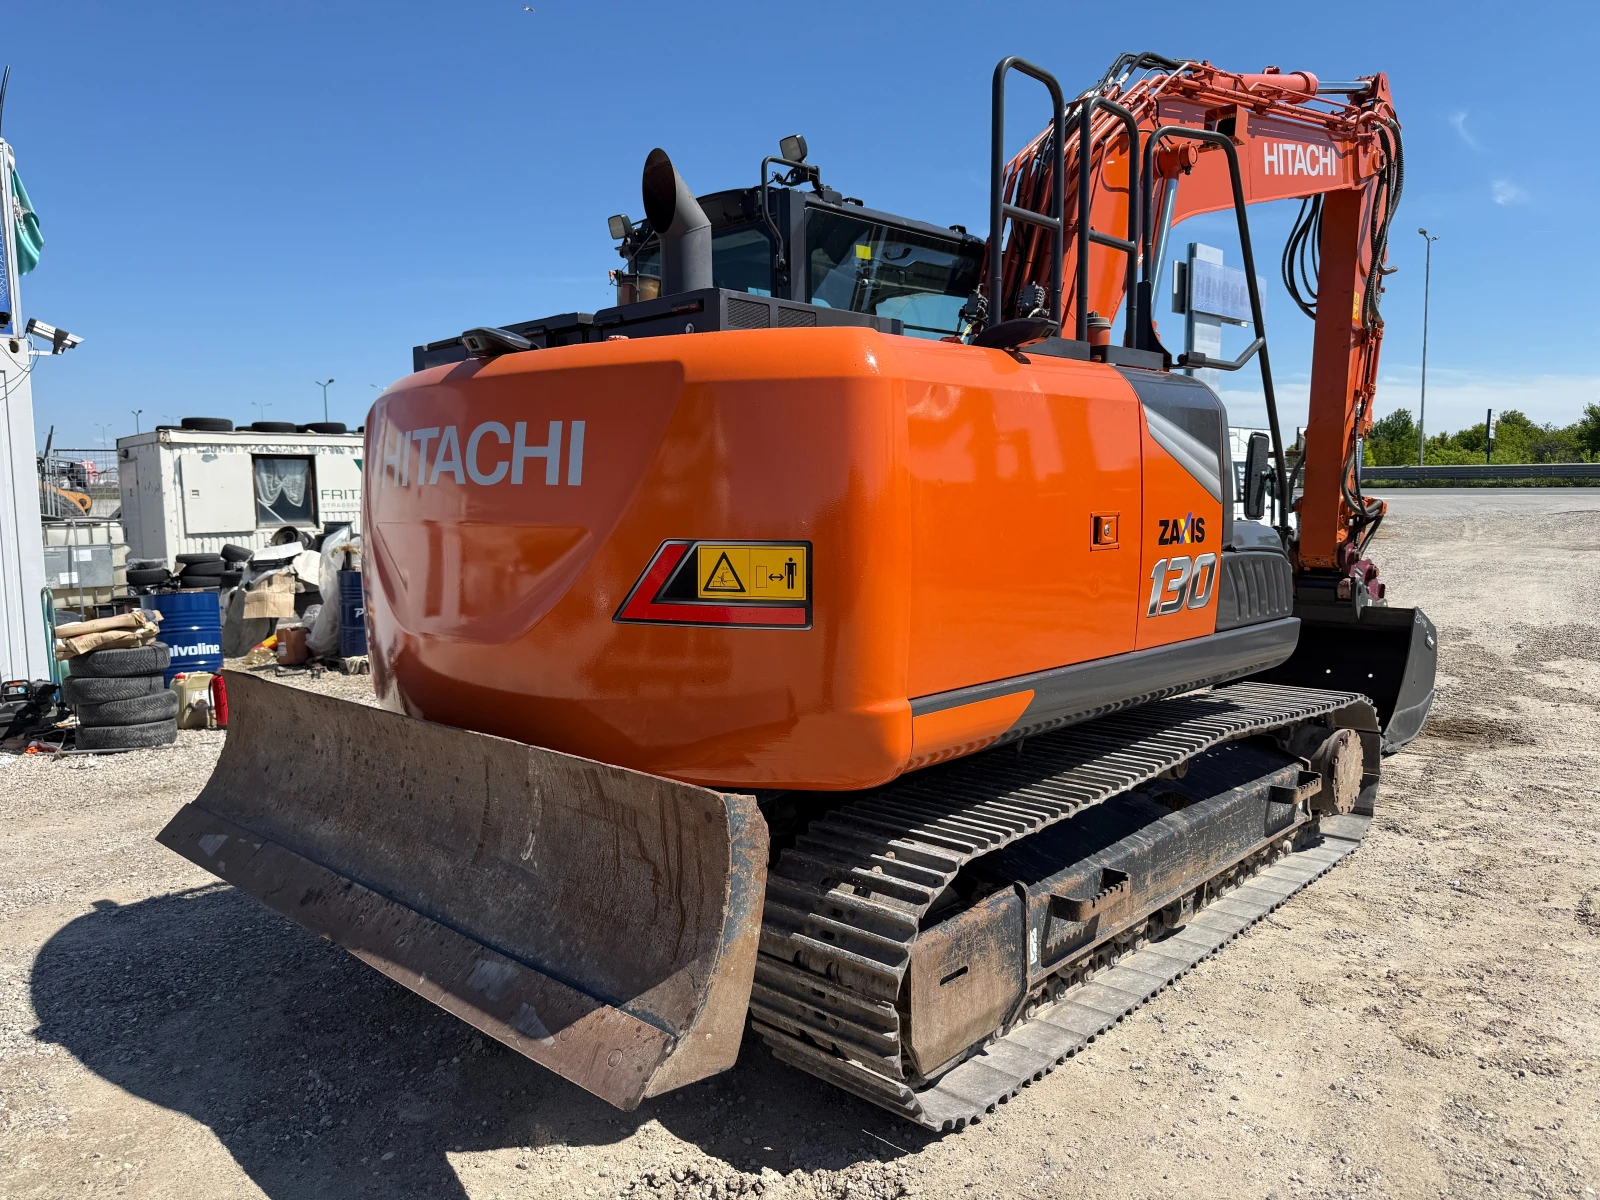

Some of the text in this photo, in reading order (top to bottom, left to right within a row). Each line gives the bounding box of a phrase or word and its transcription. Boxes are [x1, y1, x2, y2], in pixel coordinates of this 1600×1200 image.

[1263, 142, 1336, 176] HITACHI
[381, 420, 585, 488] HITACHI
[321, 489, 361, 500] FRIT
[1158, 512, 1205, 545] ZAXIS
[1146, 552, 1217, 618] 130
